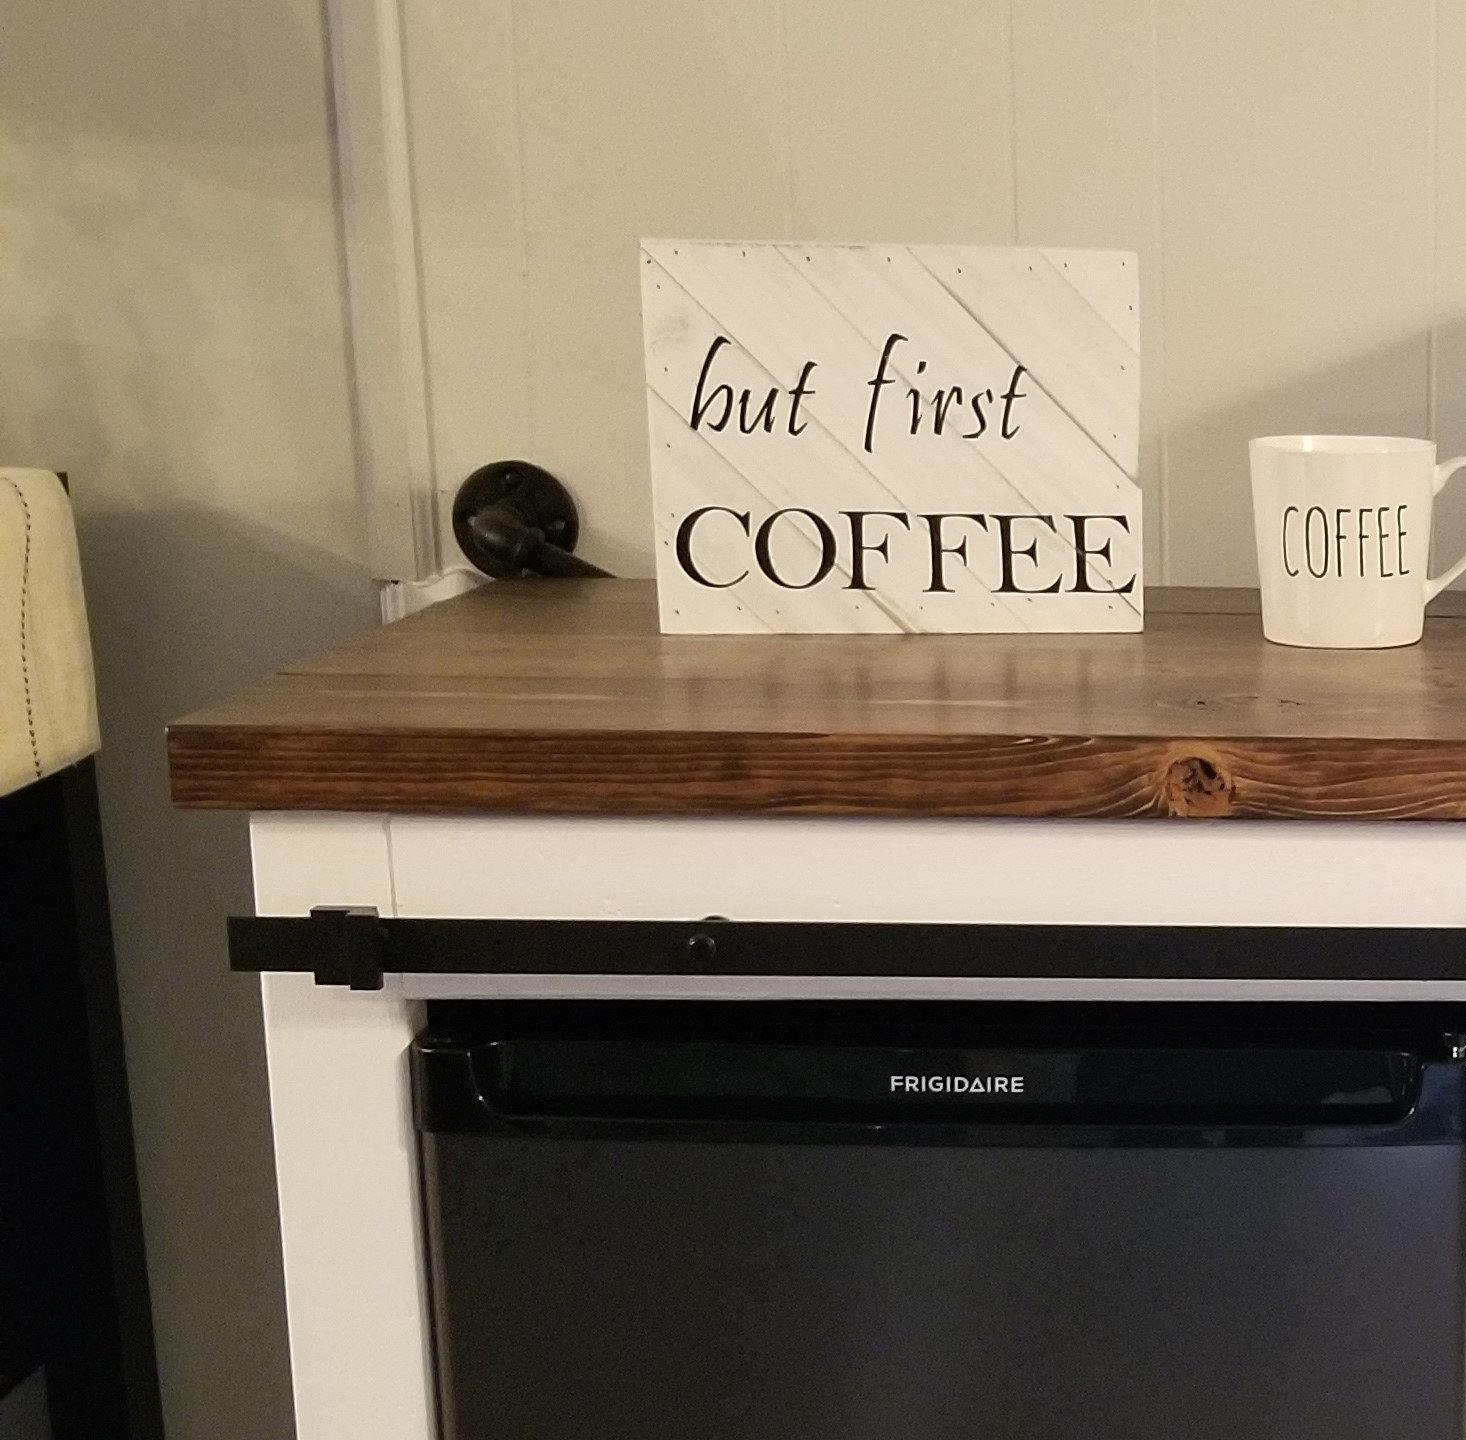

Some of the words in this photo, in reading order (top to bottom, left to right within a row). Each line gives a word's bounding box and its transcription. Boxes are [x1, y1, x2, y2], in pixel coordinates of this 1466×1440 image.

[689, 335, 818, 437] but
[863, 333, 1028, 453] first
[674, 506, 1137, 594] COFFEE
[1282, 504, 1410, 578] COFFEE
[890, 1075, 1025, 1093] FRIGIDAIRE
